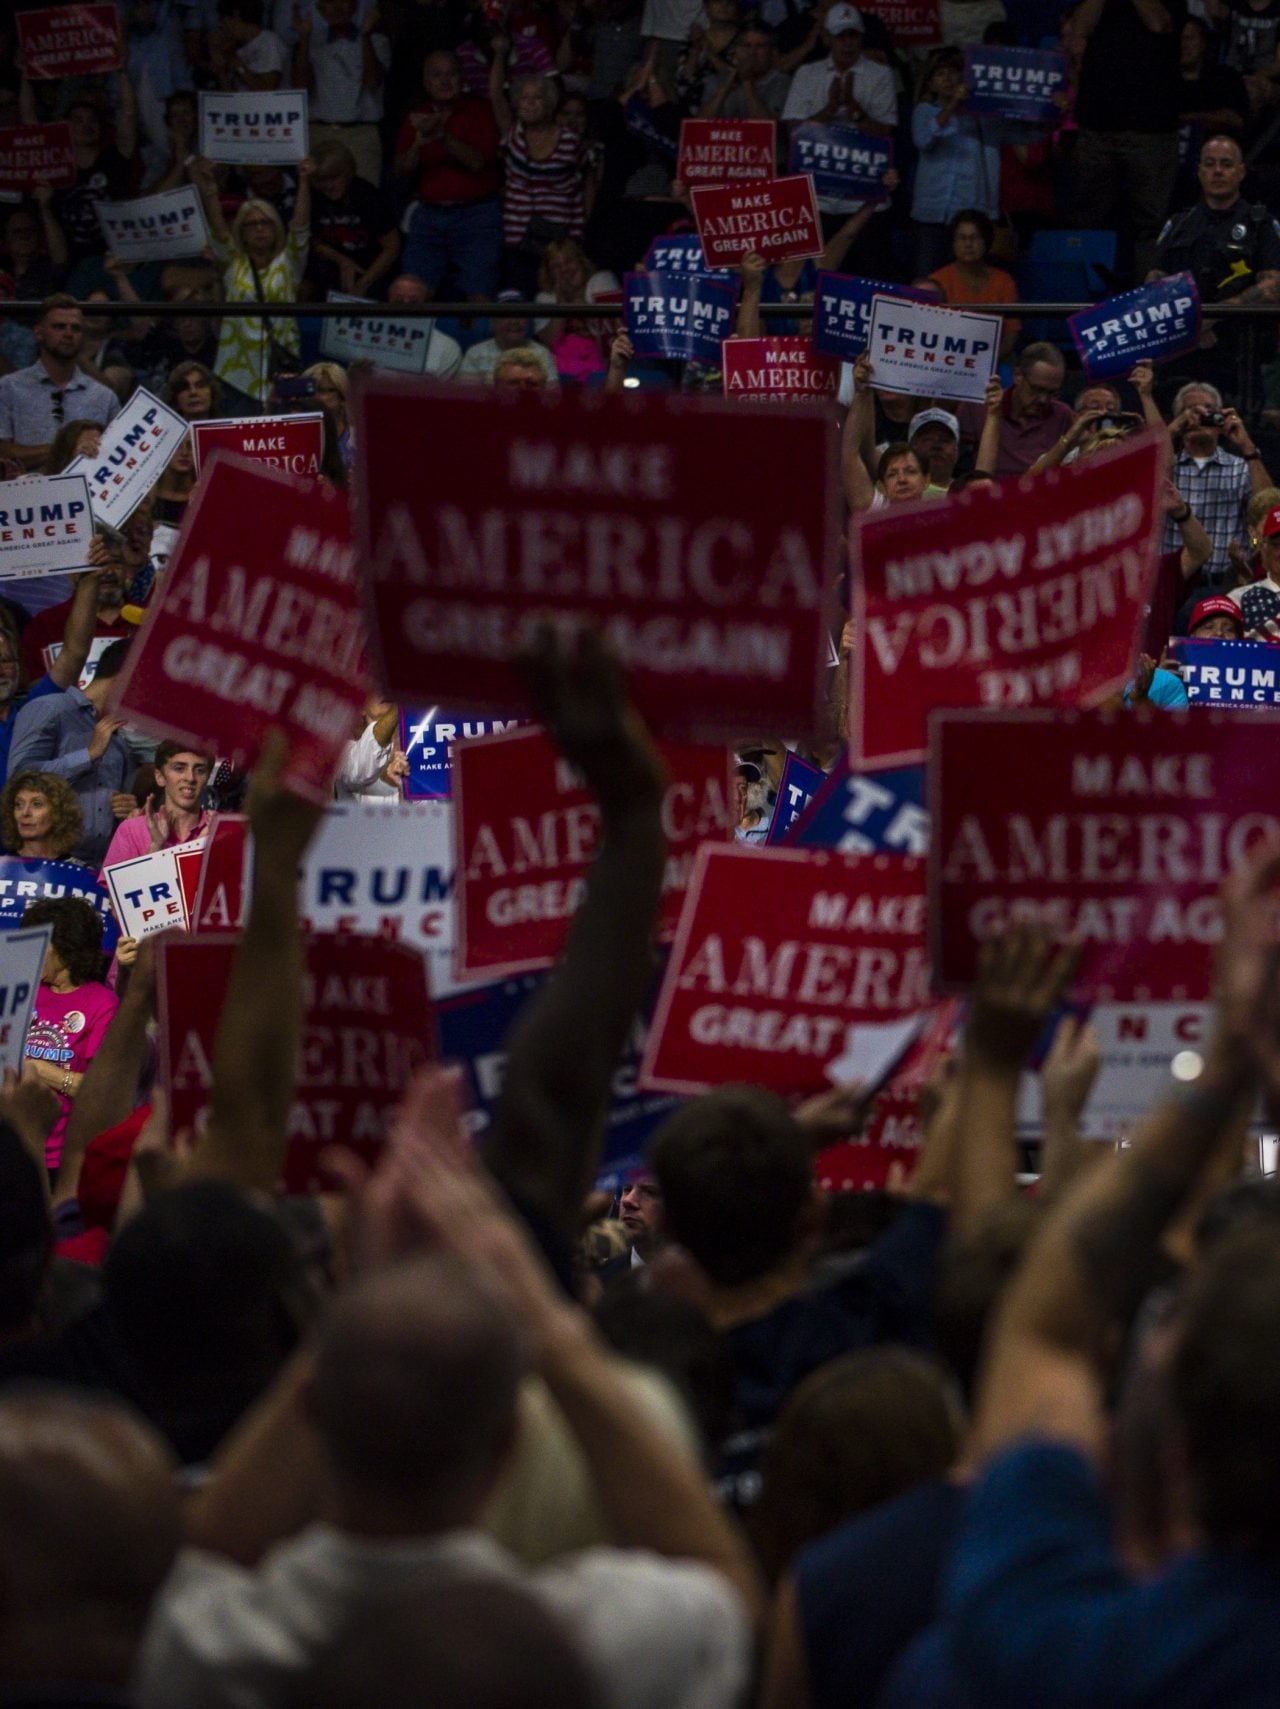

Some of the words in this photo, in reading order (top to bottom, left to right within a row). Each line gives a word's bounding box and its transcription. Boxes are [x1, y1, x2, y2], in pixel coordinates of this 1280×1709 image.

[972, 64, 1064, 86] TRUMP
[976, 80, 1053, 96] PENCE
[208, 112, 300, 127] TRUMP
[215, 127, 293, 138] PENCE
[682, 146, 772, 165] AMERICA
[798, 140, 889, 167] TRUMP
[802, 155, 880, 177] PENCE
[731, 193, 772, 211] MAKE
[107, 207, 196, 231] TRUMP
[703, 205, 814, 237] AMERICA
[712, 236, 756, 253] GREAT
[760, 229, 809, 250] AGAIN
[653, 248, 702, 262] TRU
[629, 296, 731, 322] TRUMP
[821, 295, 872, 320] TRU
[1081, 297, 1192, 342] TRUMP
[636, 314, 721, 335] PENCE
[827, 315, 870, 334] PEN
[1095, 317, 1187, 352] PENCE
[878, 324, 989, 356] TRUMP
[766, 351, 807, 364] MAKE
[884, 344, 976, 369] PENCE
[729, 369, 836, 390] AMERICA
[242, 436, 287, 452] MAKE
[100, 425, 164, 501] PENCE
[507, 438, 674, 500] MAKE
[0, 501, 85, 527] RUMP
[2, 523, 77, 542] ENCE
[372, 498, 822, 610] AMERICA
[410, 718, 522, 745] TRUM
[419, 763, 443, 771] MAKE
[1071, 752, 1215, 799] MAKE
[319, 867, 456, 907] RUM
[143, 922, 165, 933] MAKE
[688, 1002, 843, 1058] GREAT
